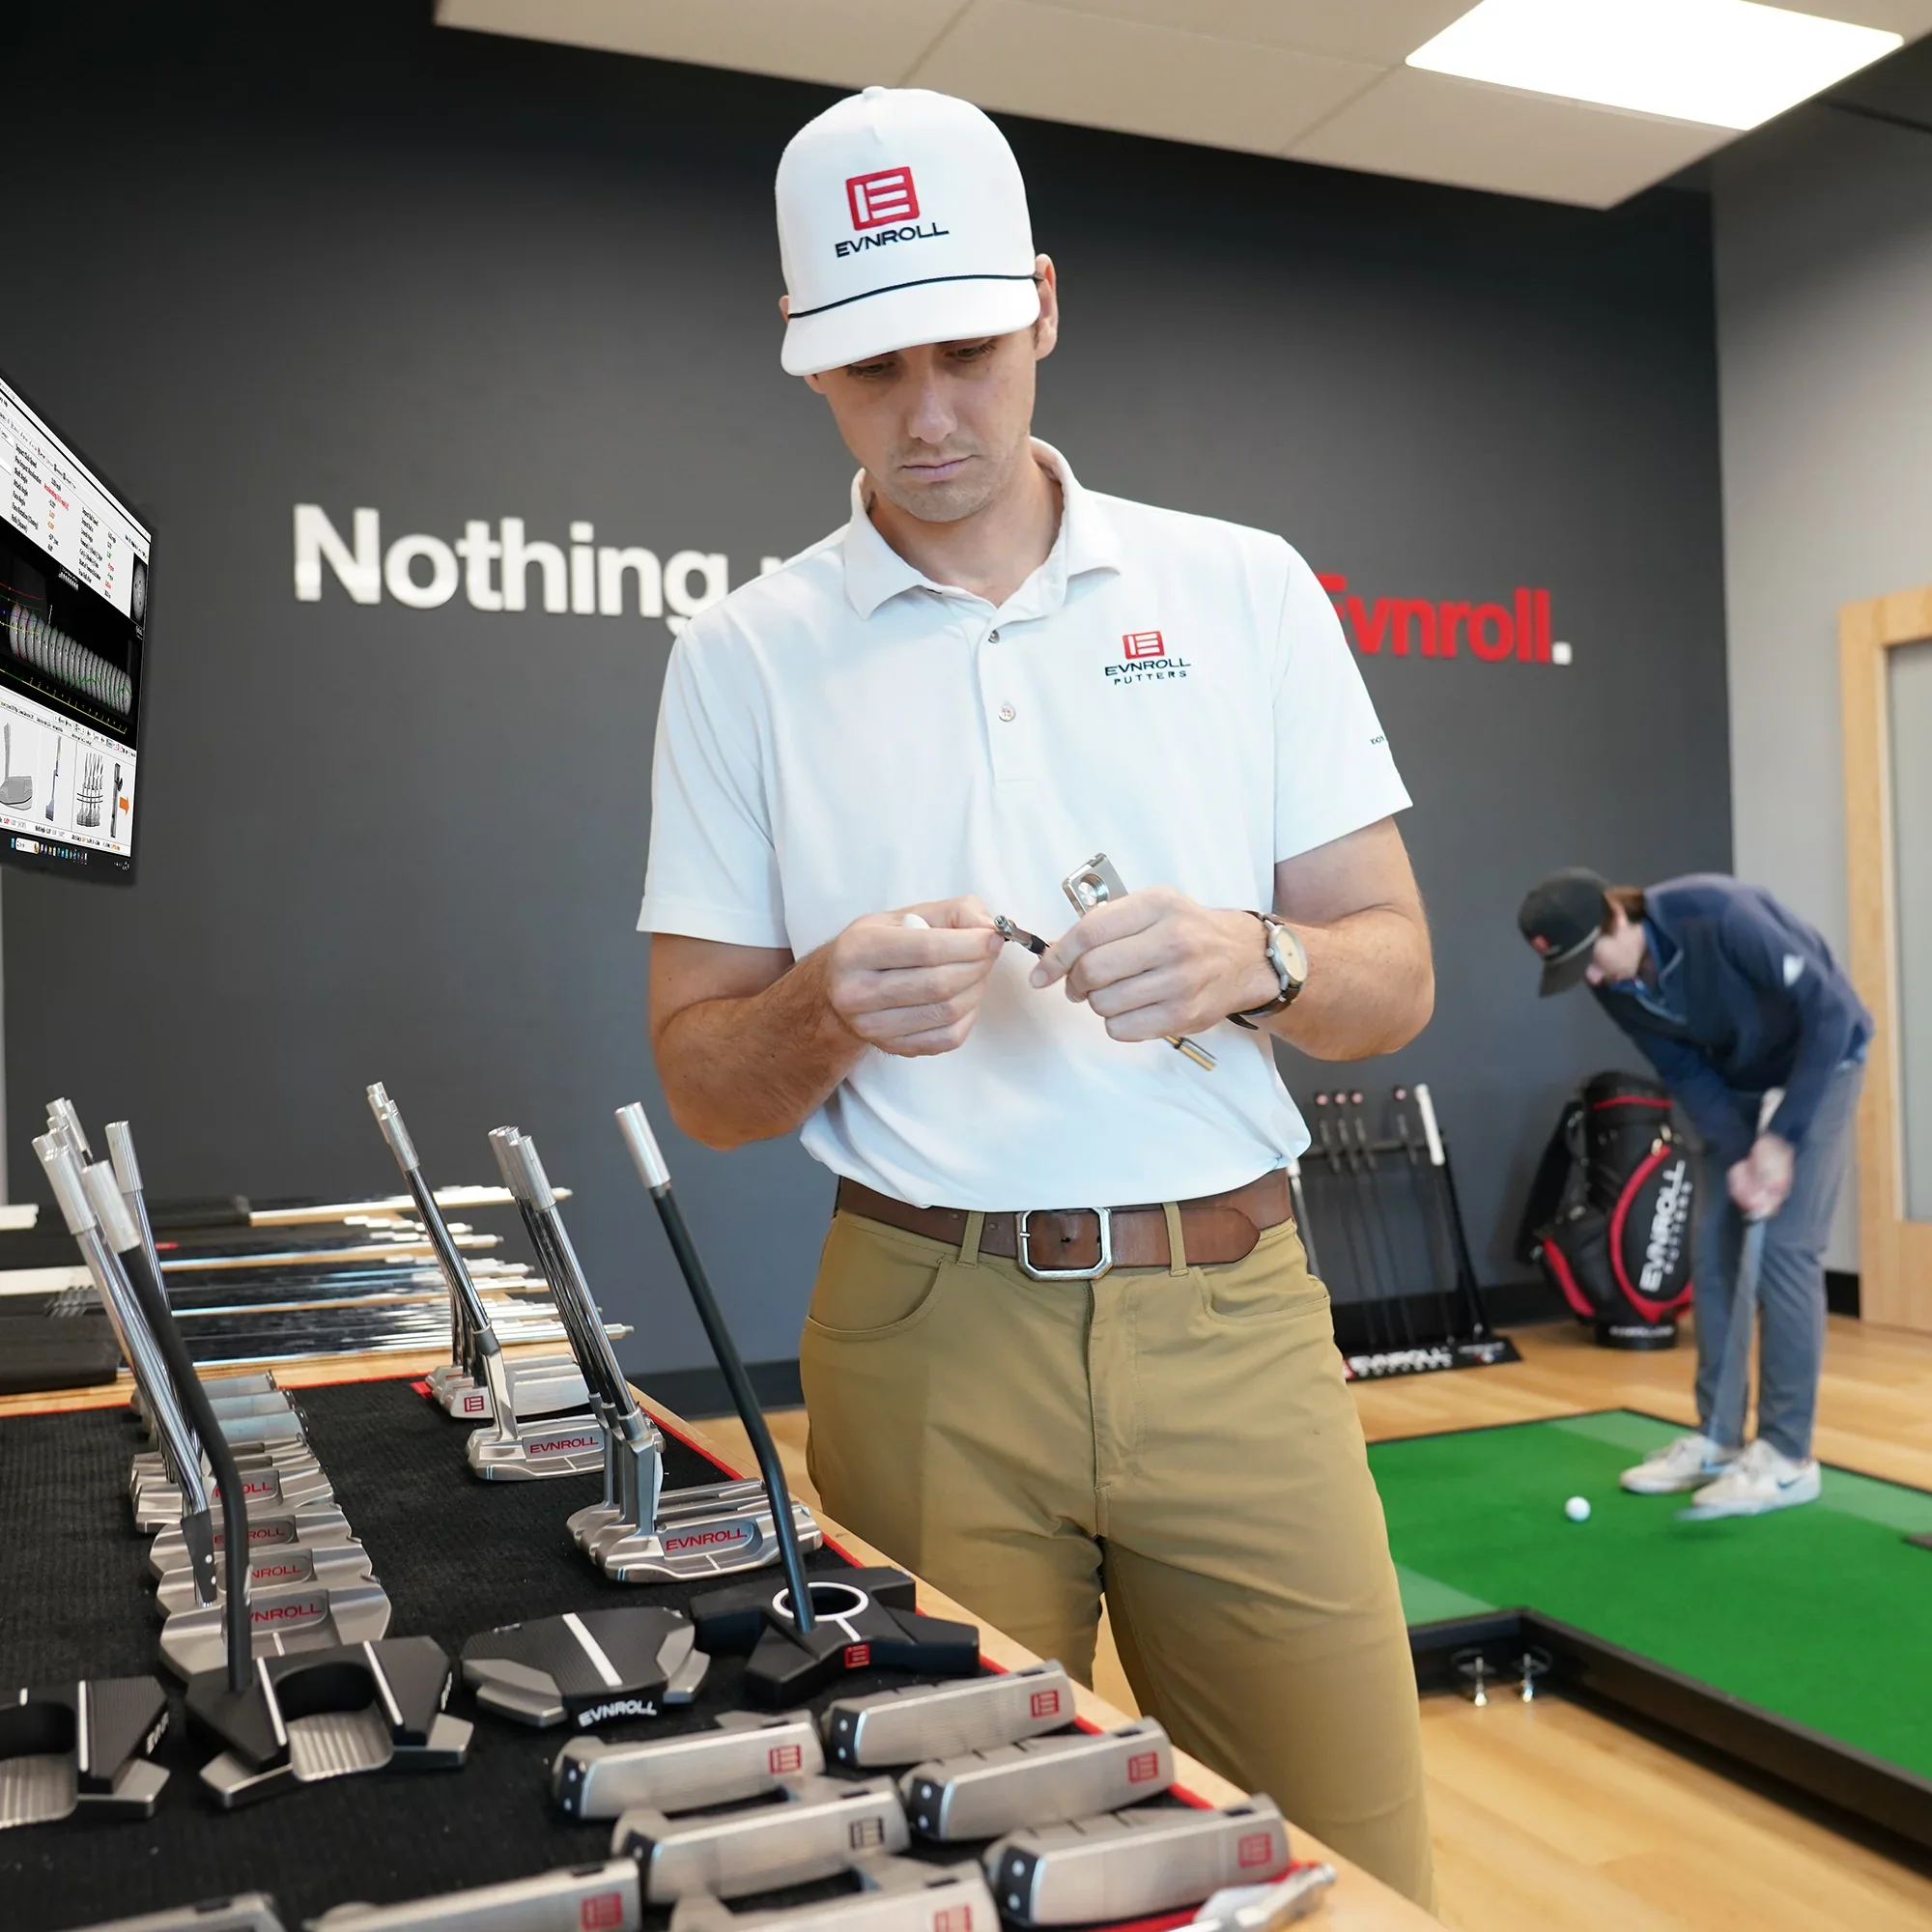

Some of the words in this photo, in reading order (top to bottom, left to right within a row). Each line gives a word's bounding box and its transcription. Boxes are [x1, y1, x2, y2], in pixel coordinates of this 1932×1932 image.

[835, 222, 950, 258] EVNROLL
[294, 502, 728, 637] Nothing
[1104, 658, 1191, 676] EVNROLL
[1114, 669, 1186, 685] PUTTERS
[529, 1435, 599, 1454] EVNROLL
[665, 1526, 748, 1551] EVNROLL
[578, 1699, 658, 1728] EVNROLL
